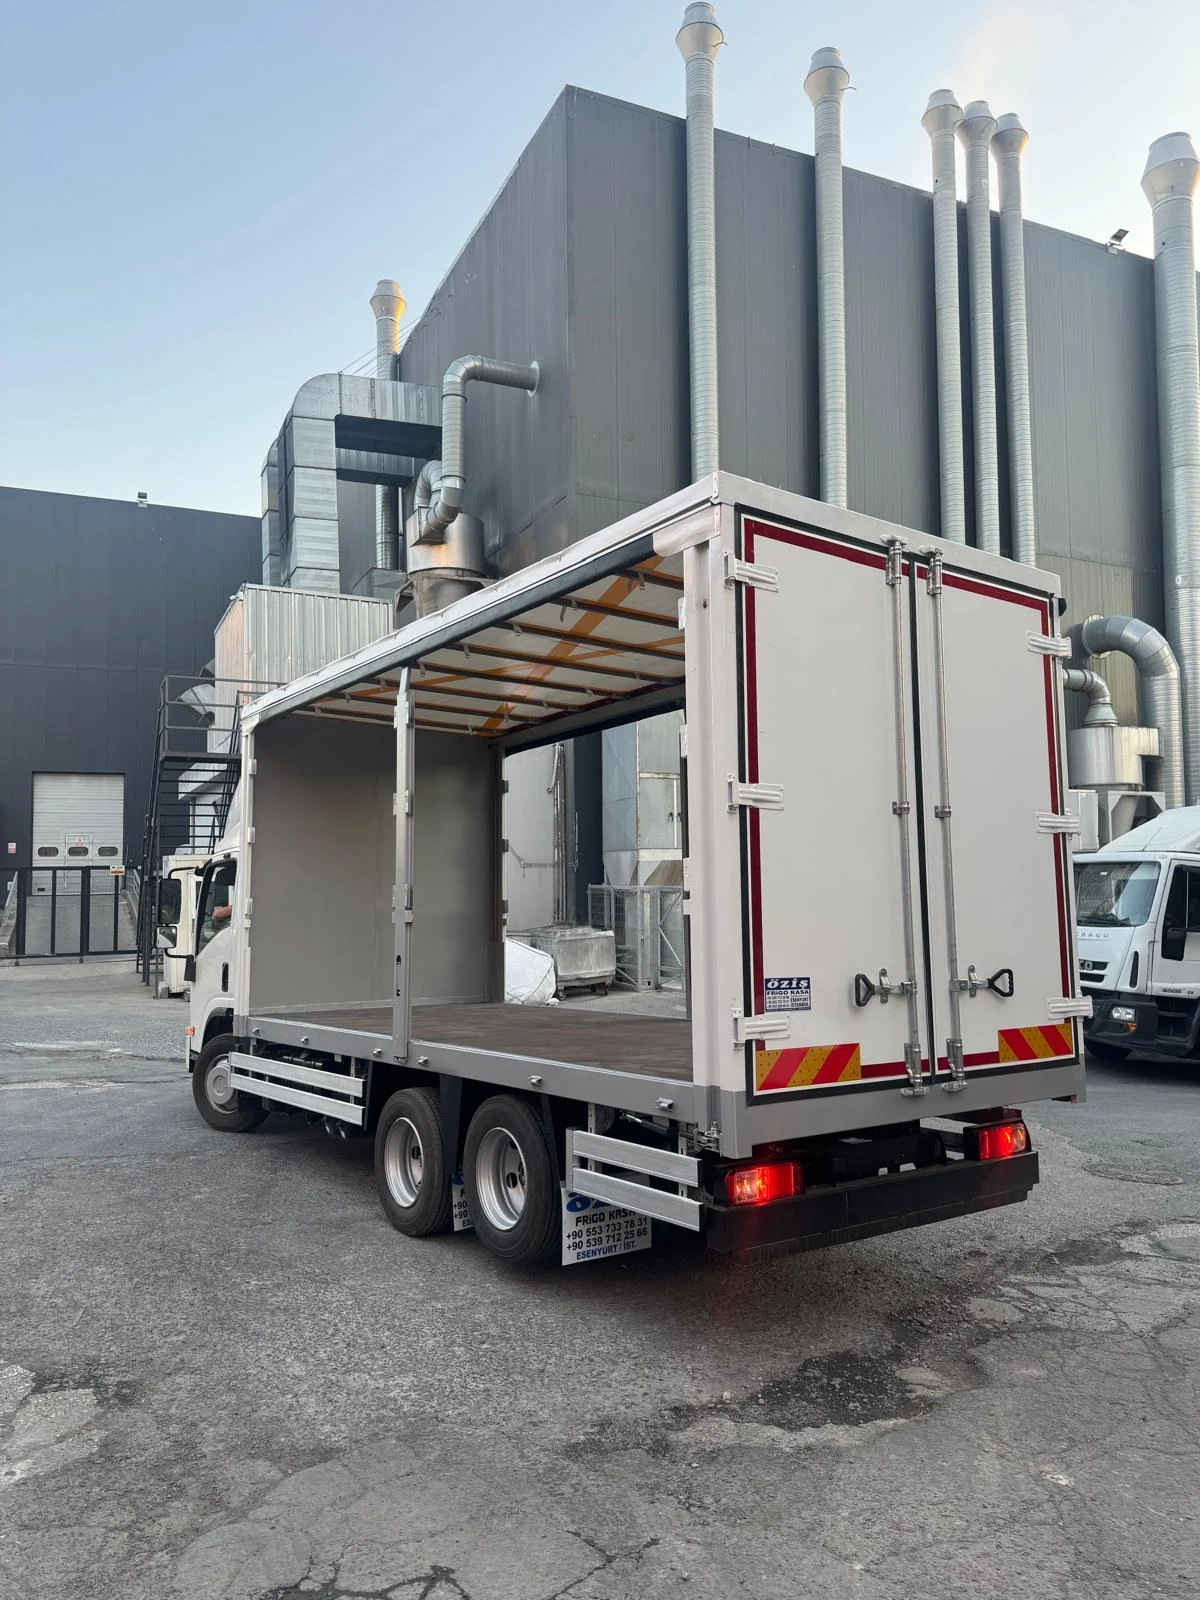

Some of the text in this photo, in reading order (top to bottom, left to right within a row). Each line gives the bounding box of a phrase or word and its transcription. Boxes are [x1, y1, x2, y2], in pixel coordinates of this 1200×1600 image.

[566, 1217, 648, 1240] +90 553 733 78 31
[566, 1227, 648, 1251] +90 539 712 25 66
[576, 1244, 619, 1260] ESENYURT
